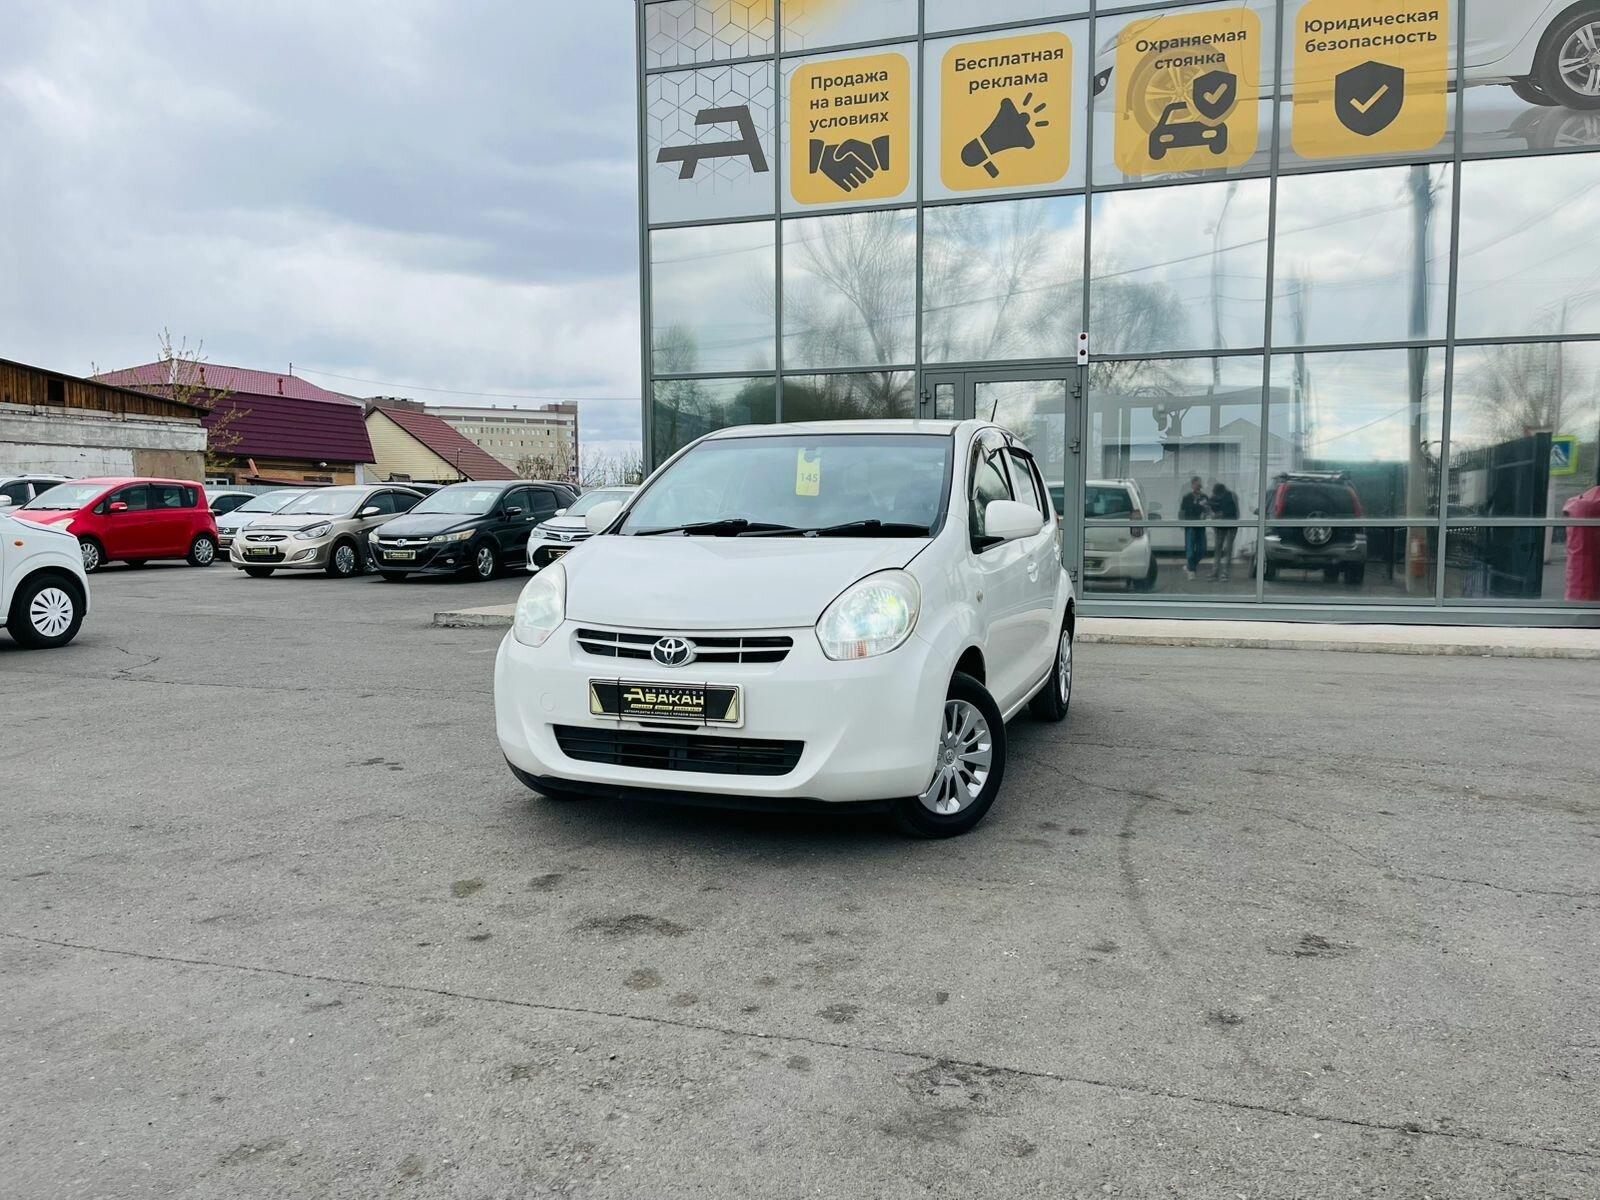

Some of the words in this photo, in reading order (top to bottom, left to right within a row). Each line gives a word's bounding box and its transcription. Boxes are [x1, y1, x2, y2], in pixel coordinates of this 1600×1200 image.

[1304, 10, 1438, 34] Юридическая
[1136, 30, 1246, 53] Охраняемая
[1304, 32, 1437, 53] безопасность
[956, 48, 1064, 72] Бесплатная
[1155, 52, 1226, 70] стоянка
[811, 70, 888, 91] Продажа
[969, 72, 1048, 95] реклама
[810, 98, 829, 110] на
[834, 91, 889, 107] ваших
[810, 112, 889, 133] условиях
[801, 472, 818, 482] 145
[623, 688, 704, 705] АБАКАН
